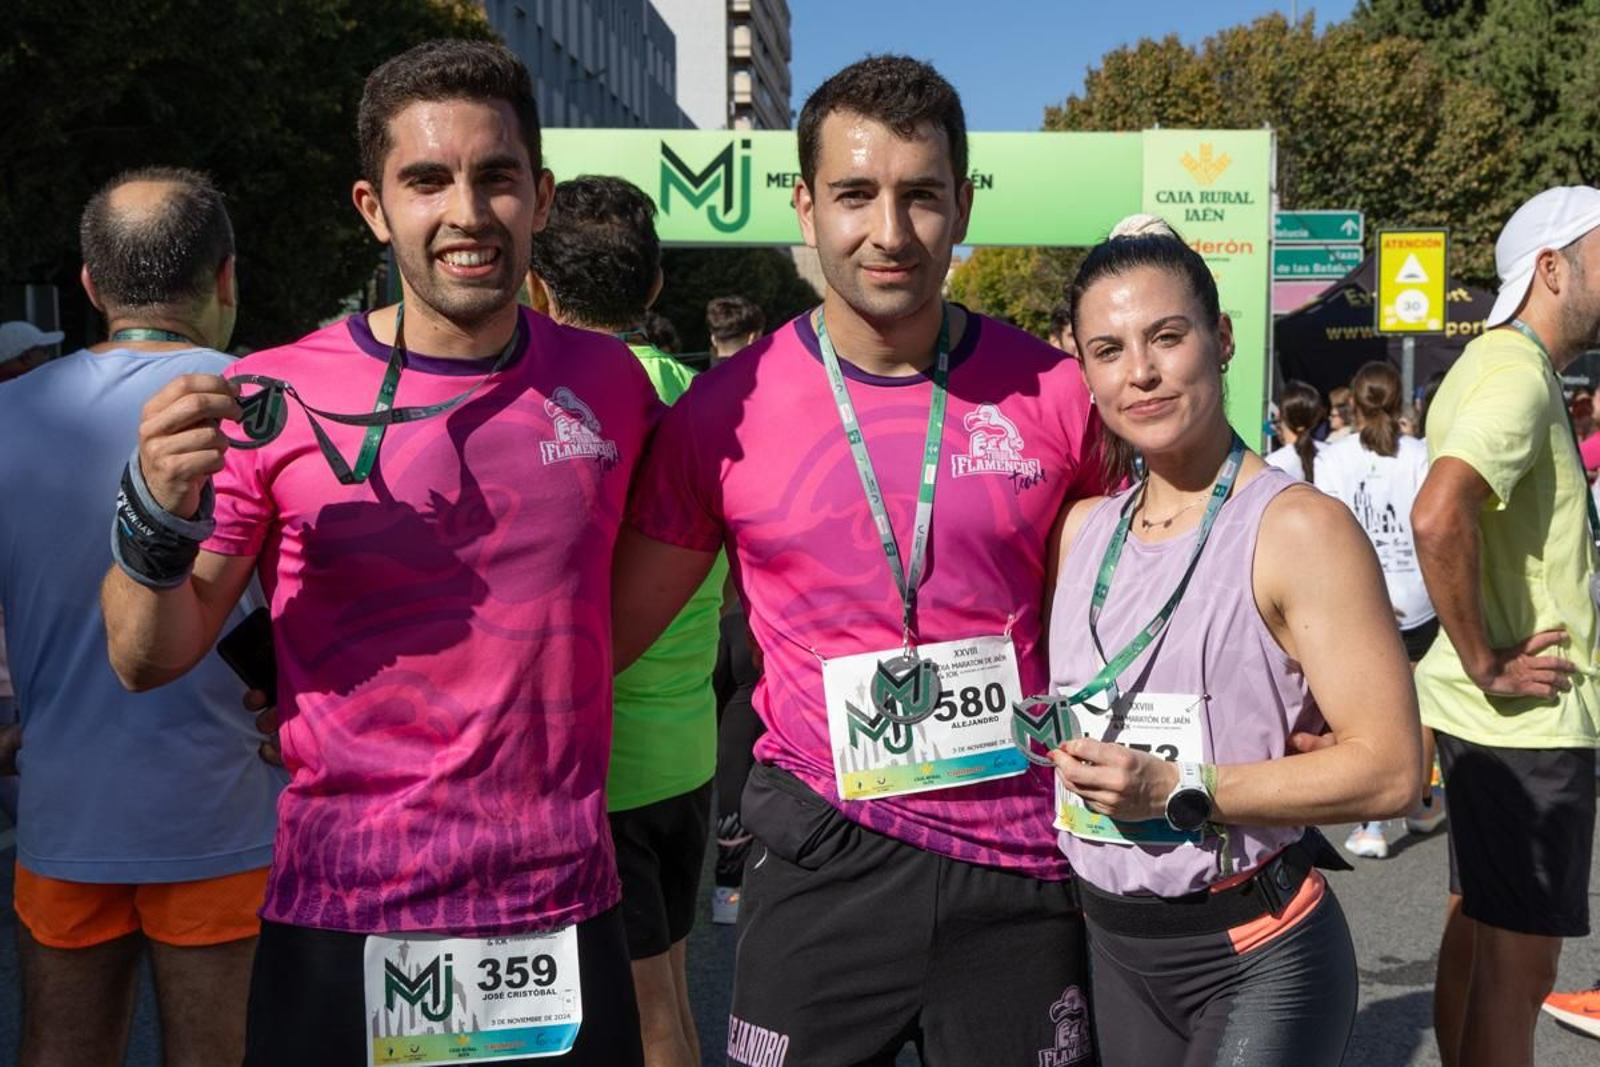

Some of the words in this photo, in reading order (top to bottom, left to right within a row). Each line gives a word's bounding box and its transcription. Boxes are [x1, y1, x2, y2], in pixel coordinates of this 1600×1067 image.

[971, 168, 993, 189] ÉN
[1200, 191, 1255, 204] RURAL
[1384, 237, 1442, 249] ATENCIÓN
[1403, 300, 1421, 312] 30
[957, 455, 1036, 476] FLAMENCOS
[933, 682, 1006, 722] 580
[951, 715, 1000, 729] ALEJANDRO
[477, 954, 557, 992] 359
[482, 991, 505, 1001] JOSÉ
[507, 988, 557, 999] CRISTÓBAL
[507, 1015, 542, 1024] NOVIEMBRE
